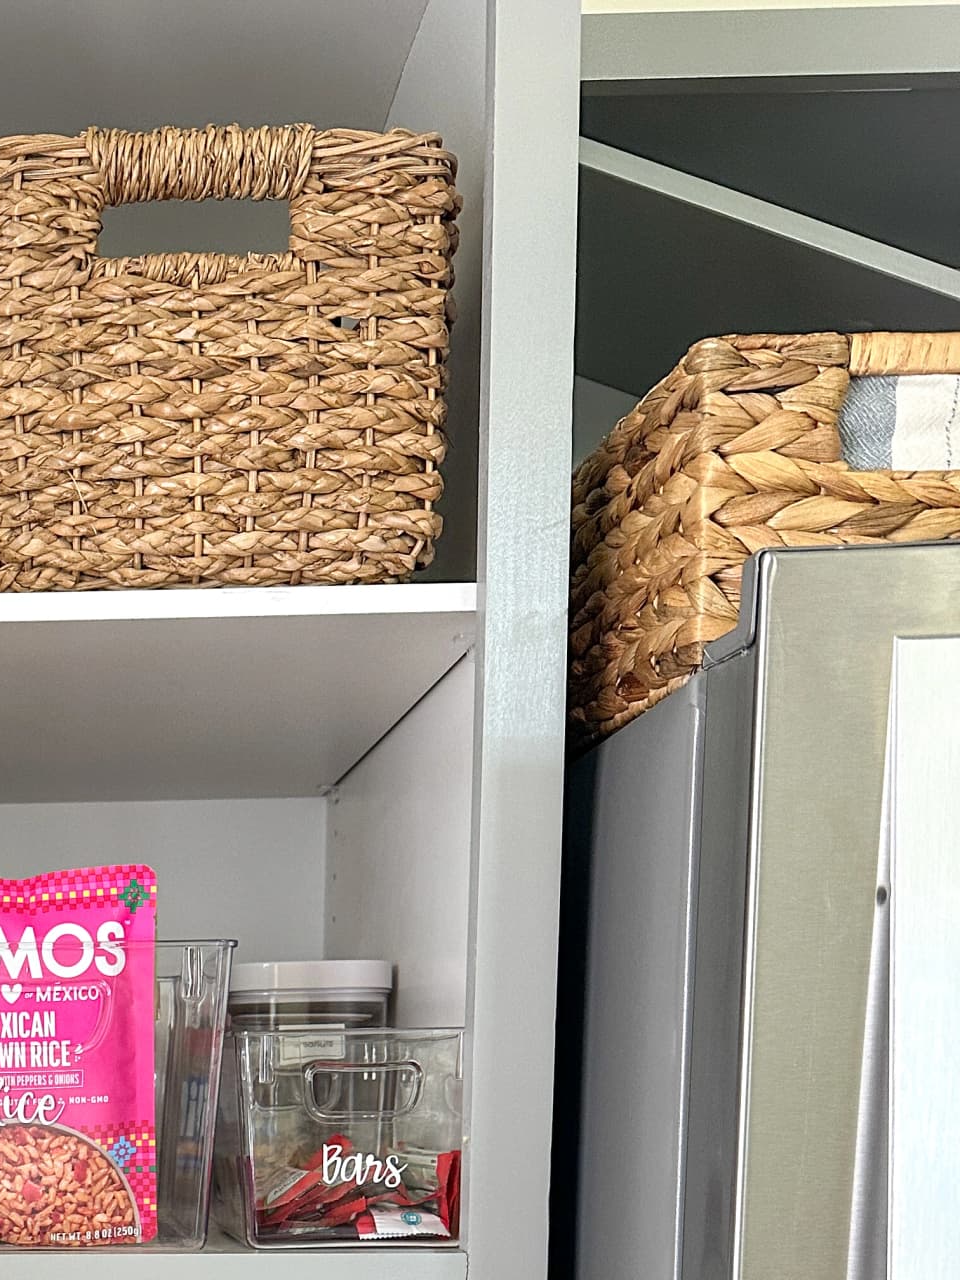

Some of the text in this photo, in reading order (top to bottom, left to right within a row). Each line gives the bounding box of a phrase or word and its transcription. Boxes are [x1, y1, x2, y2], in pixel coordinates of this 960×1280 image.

[36, 982, 100, 1003] MÉXICO
[30, 1040, 71, 1067] RICE
[16, 1074, 80, 1087] PEPPERS ONIONS
[69, 1095, 109, 1104] NON-GMO
[321, 1143, 408, 1188] Bars
[50, 1229, 113, 1241] NET 8.8 OZ
